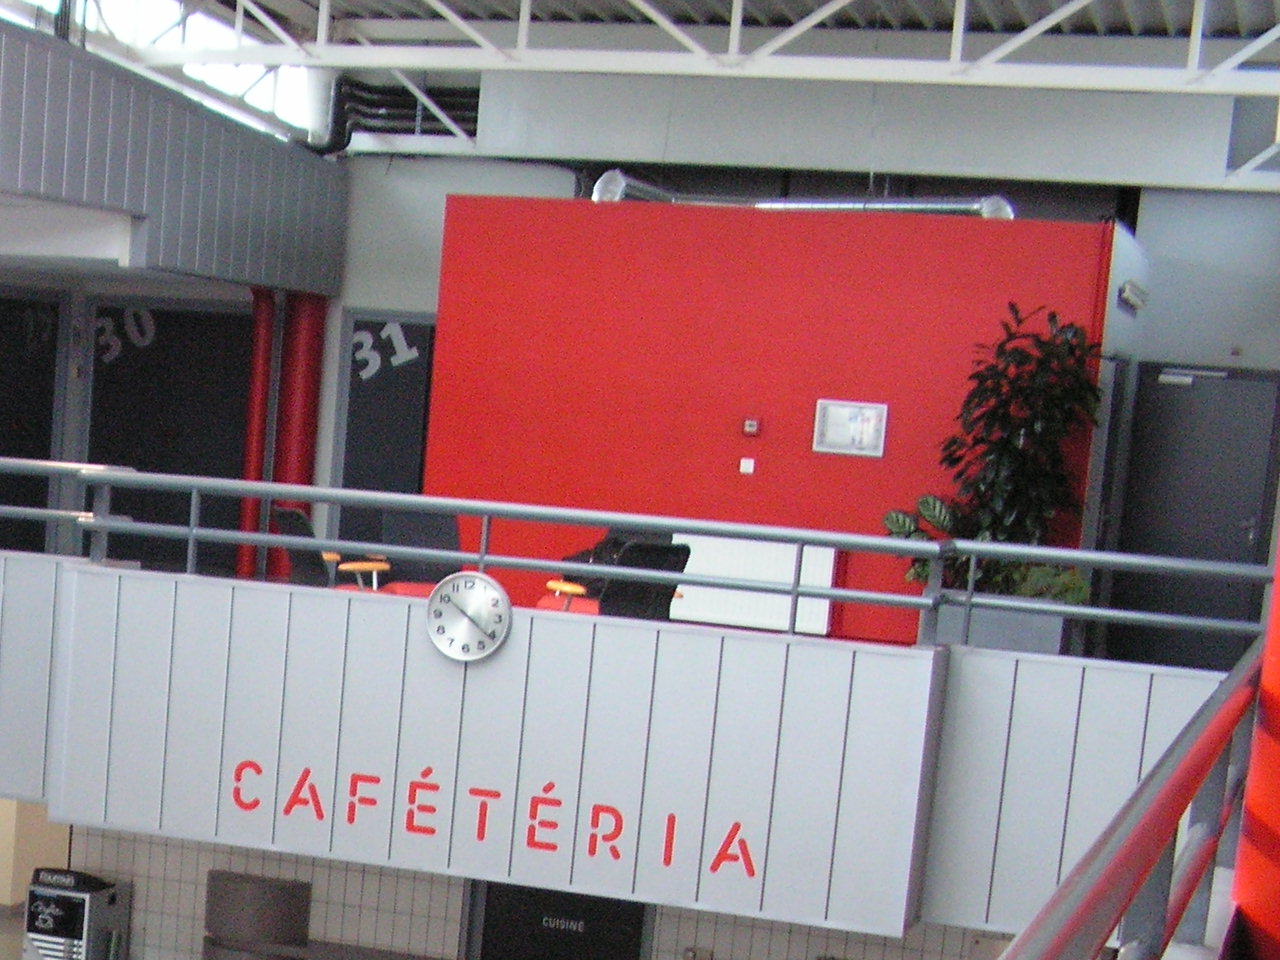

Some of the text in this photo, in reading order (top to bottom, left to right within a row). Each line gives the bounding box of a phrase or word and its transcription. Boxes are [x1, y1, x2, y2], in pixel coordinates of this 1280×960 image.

[94, 309, 155, 362] 30
[352, 322, 419, 379] 31
[464, 580, 476, 590] 12
[231, 760, 756, 878] CAFÉTÉRIA
